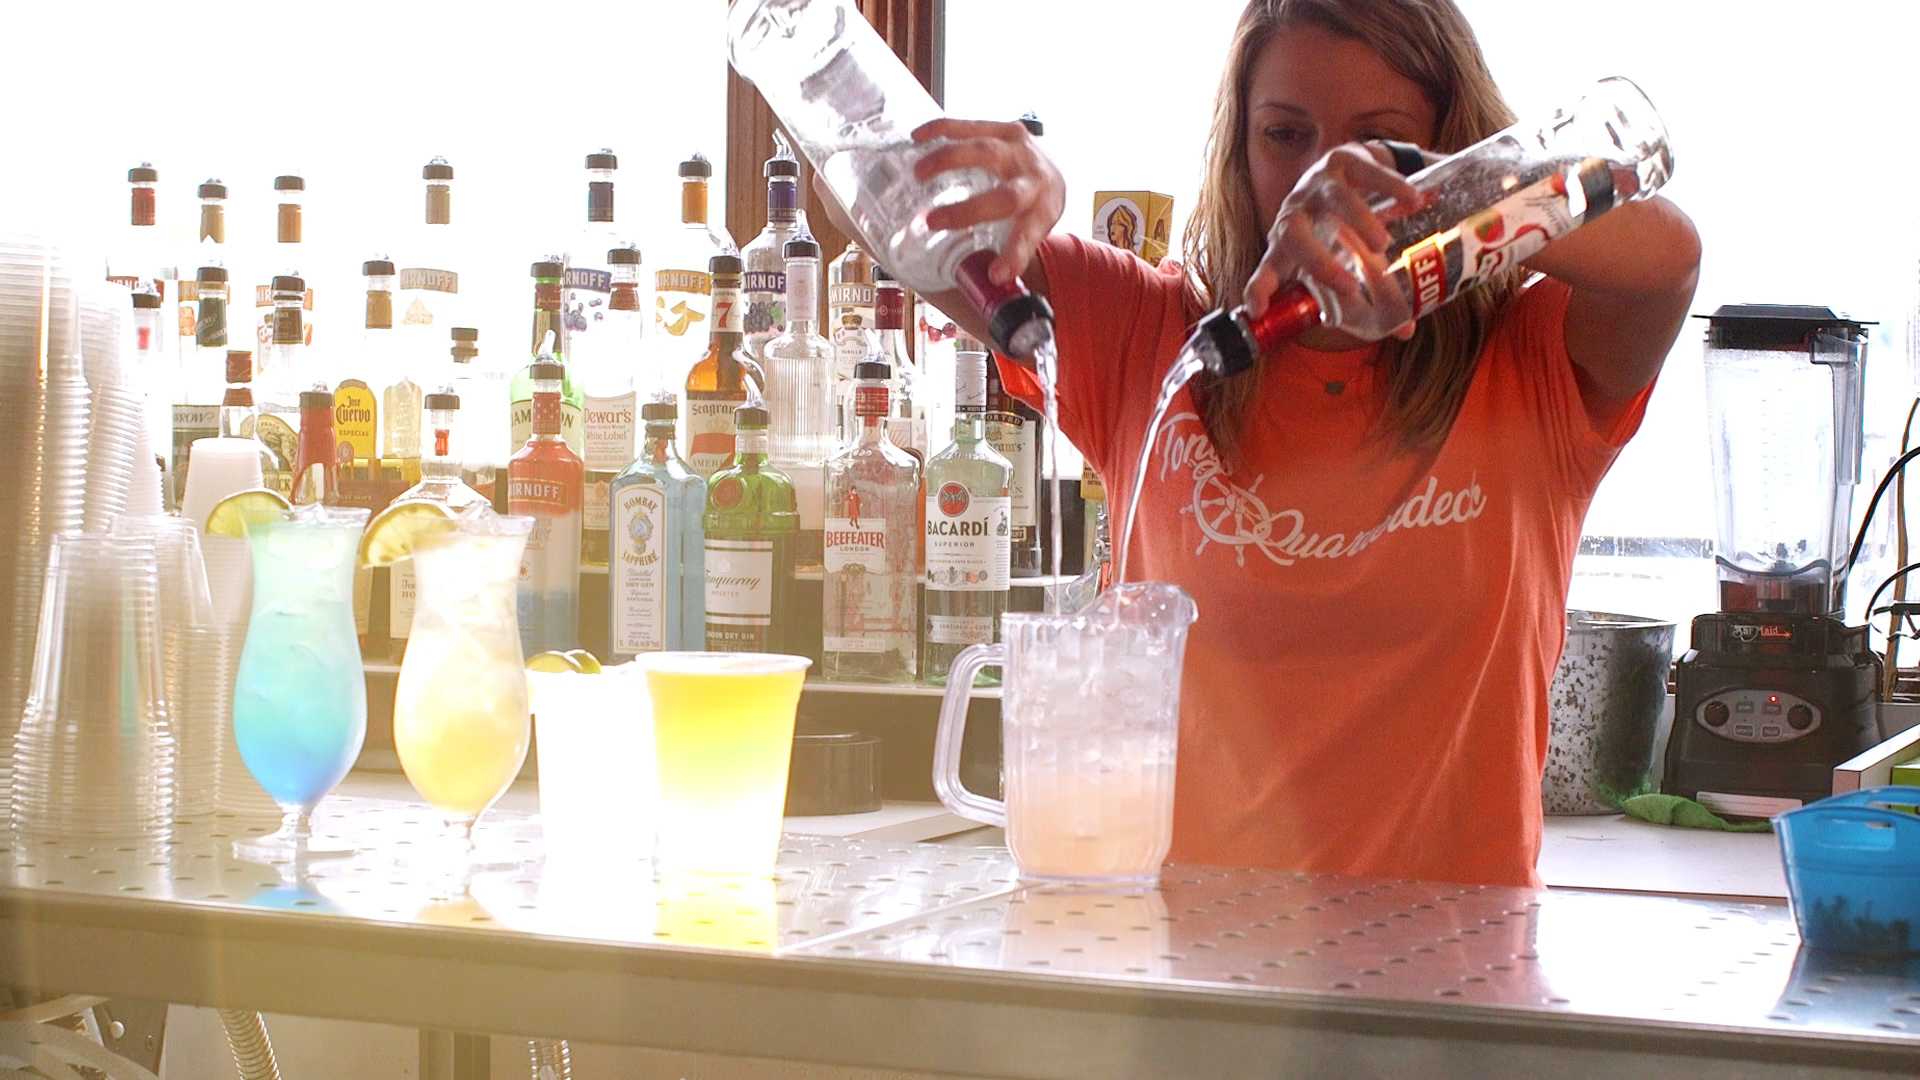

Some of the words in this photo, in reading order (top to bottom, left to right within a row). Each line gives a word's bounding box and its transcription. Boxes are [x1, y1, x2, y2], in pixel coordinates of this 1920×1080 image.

[716, 302, 733, 328] 7
[336, 404, 371, 425] Cuervo
[584, 407, 633, 424] Dewar's
[603, 431, 628, 440] Label
[623, 496, 659, 514] BOMBAY
[927, 516, 989, 537] BACARDÍ
[826, 531, 885, 549] BEEFEATER
[621, 549, 661, 566] SAPPHIRE
